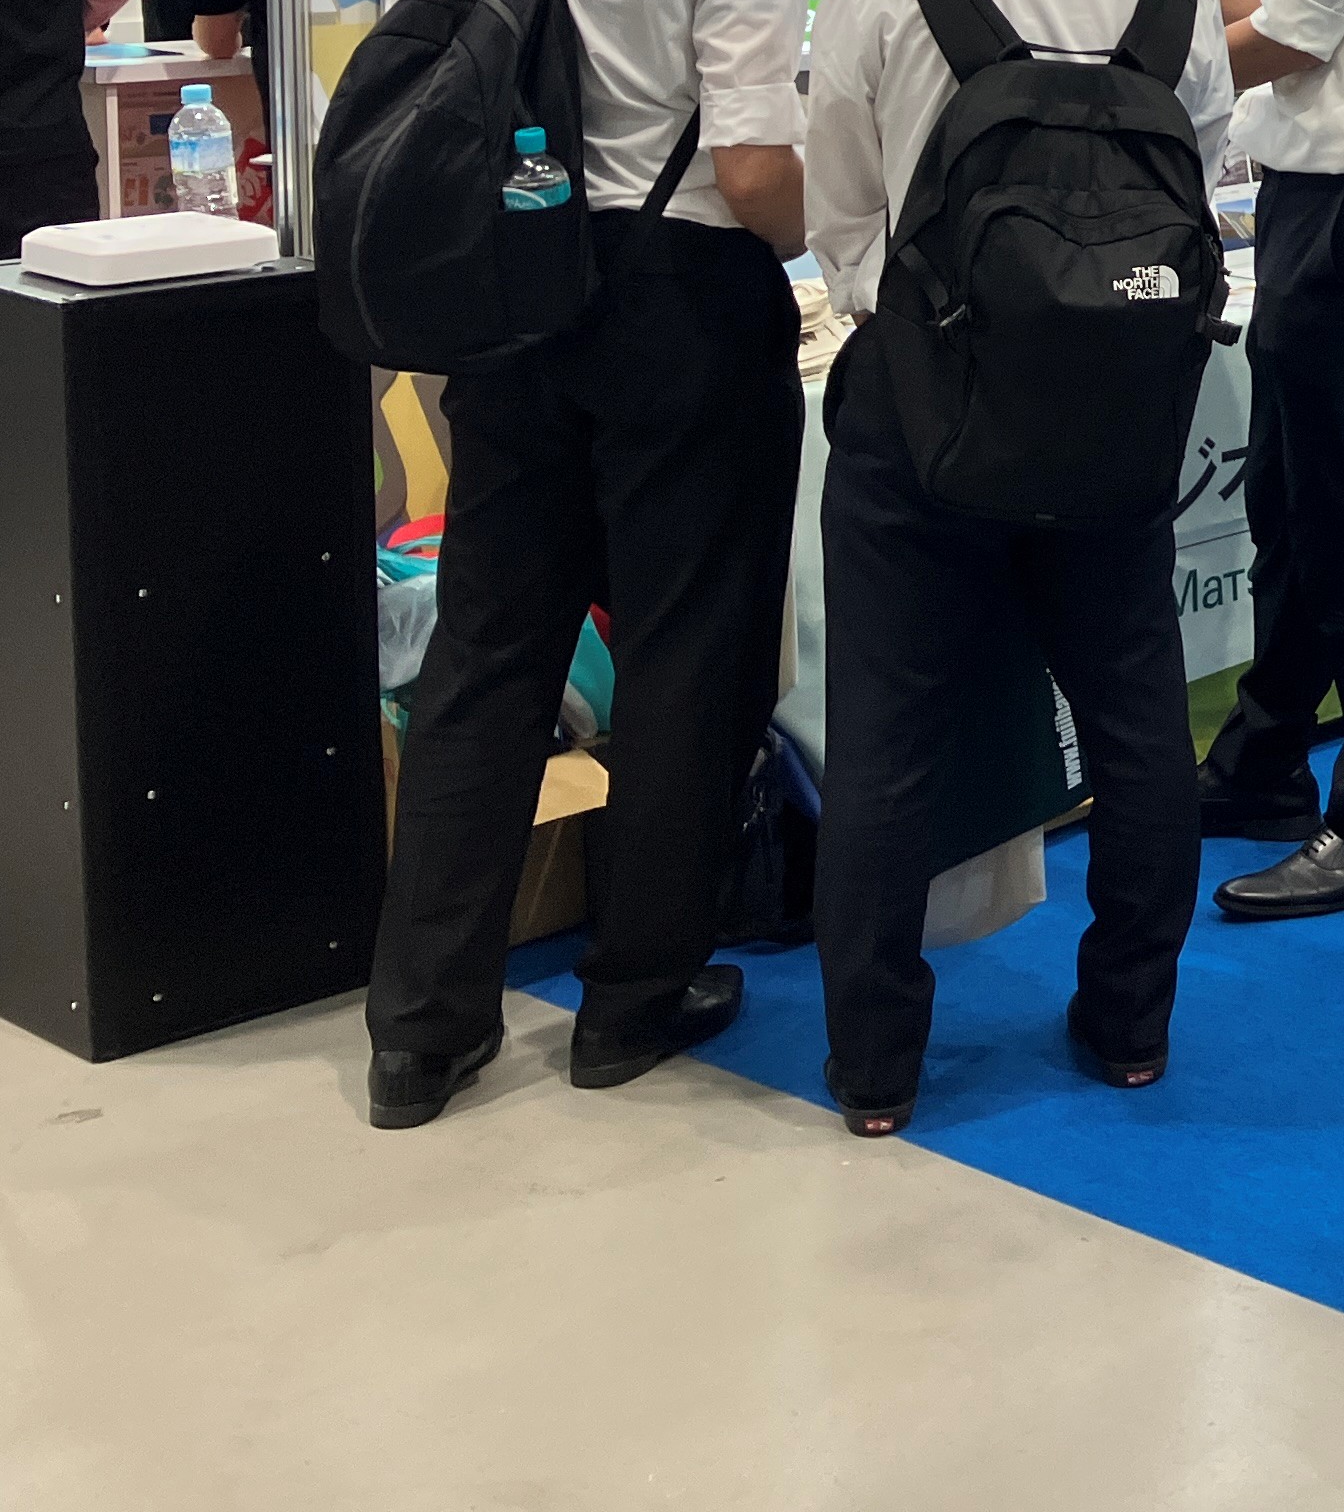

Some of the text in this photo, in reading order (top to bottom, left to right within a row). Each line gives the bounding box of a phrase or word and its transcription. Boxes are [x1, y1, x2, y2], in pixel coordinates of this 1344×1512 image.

[1132, 265, 1160, 278] THE
[1113, 276, 1160, 291] NORTH
[1127, 287, 1160, 301] FACE
